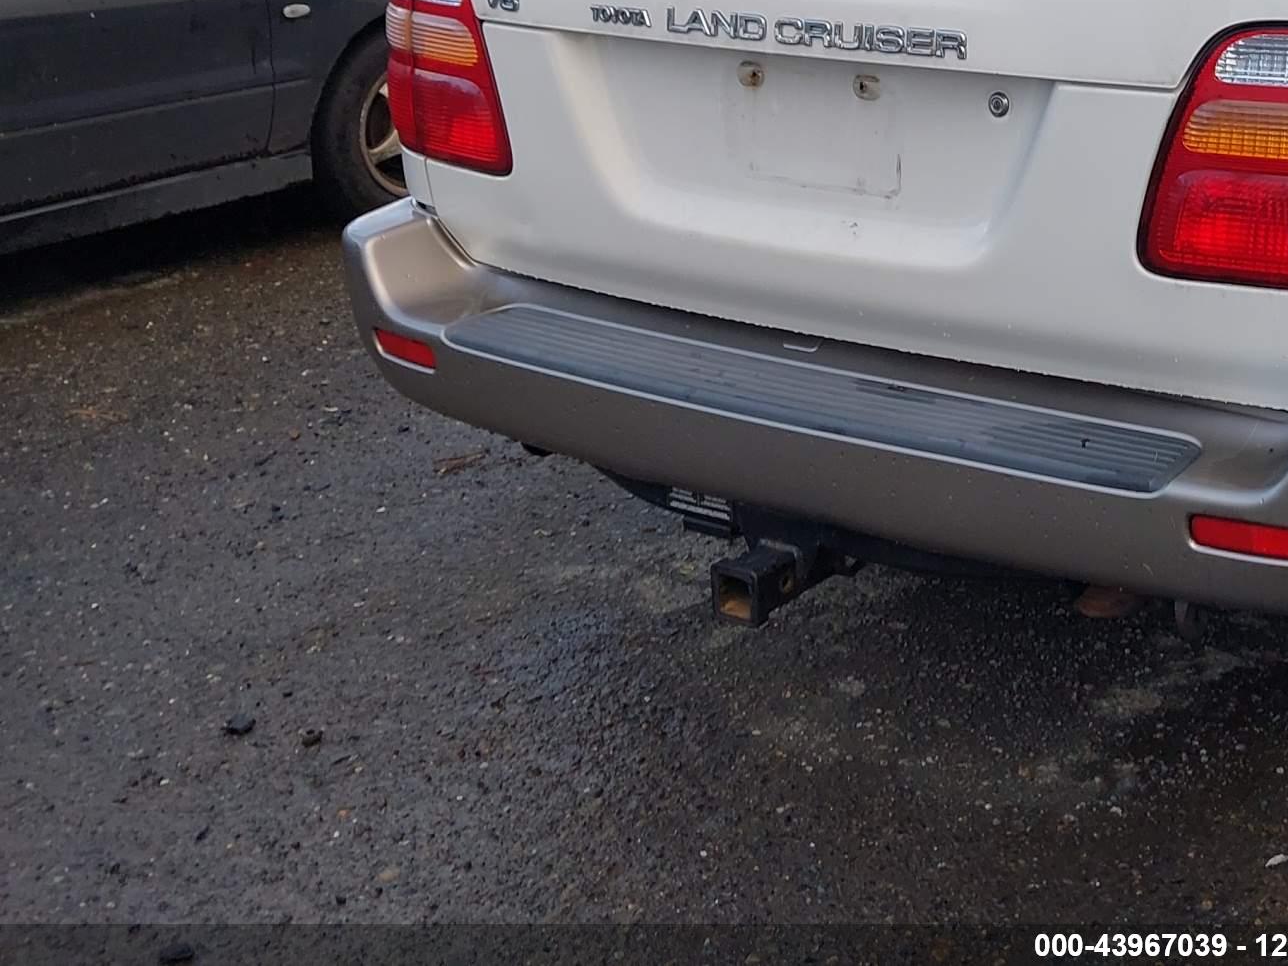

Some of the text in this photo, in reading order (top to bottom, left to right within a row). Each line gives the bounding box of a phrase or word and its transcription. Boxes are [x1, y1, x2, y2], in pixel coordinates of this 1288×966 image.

[591, 4, 967, 60] TOYOTA LAND CRUISER
